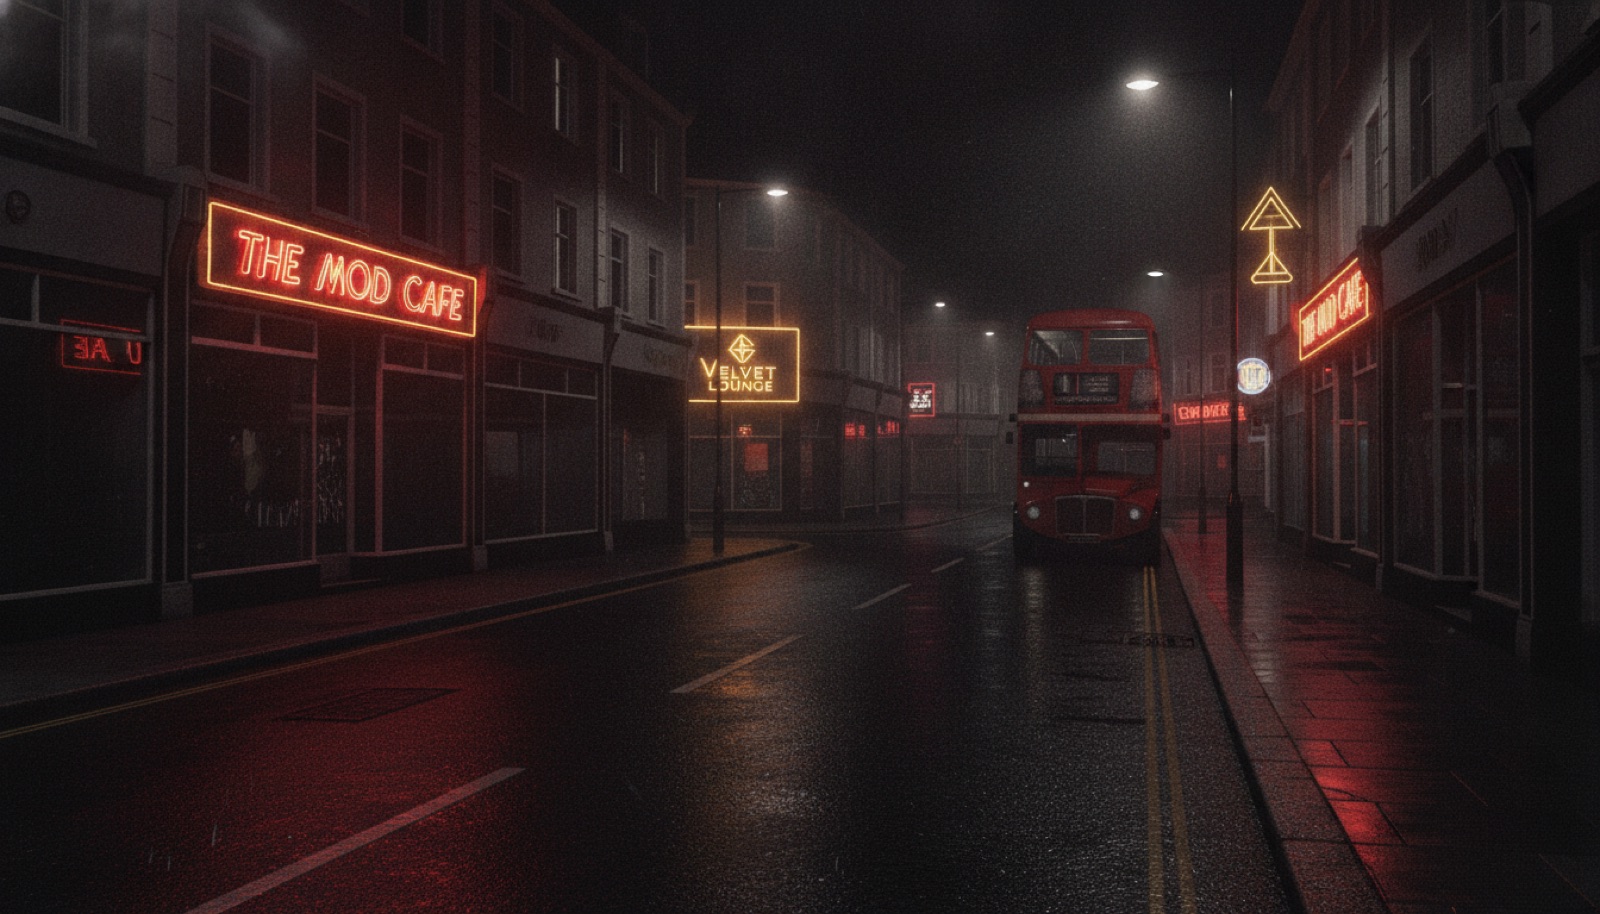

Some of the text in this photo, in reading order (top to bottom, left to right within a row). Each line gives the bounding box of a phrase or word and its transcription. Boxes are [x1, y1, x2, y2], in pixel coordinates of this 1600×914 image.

[237, 229, 465, 322] THE MOD CAFE
[700, 357, 777, 381] VELVET
[708, 379, 774, 393] LOUNGE
